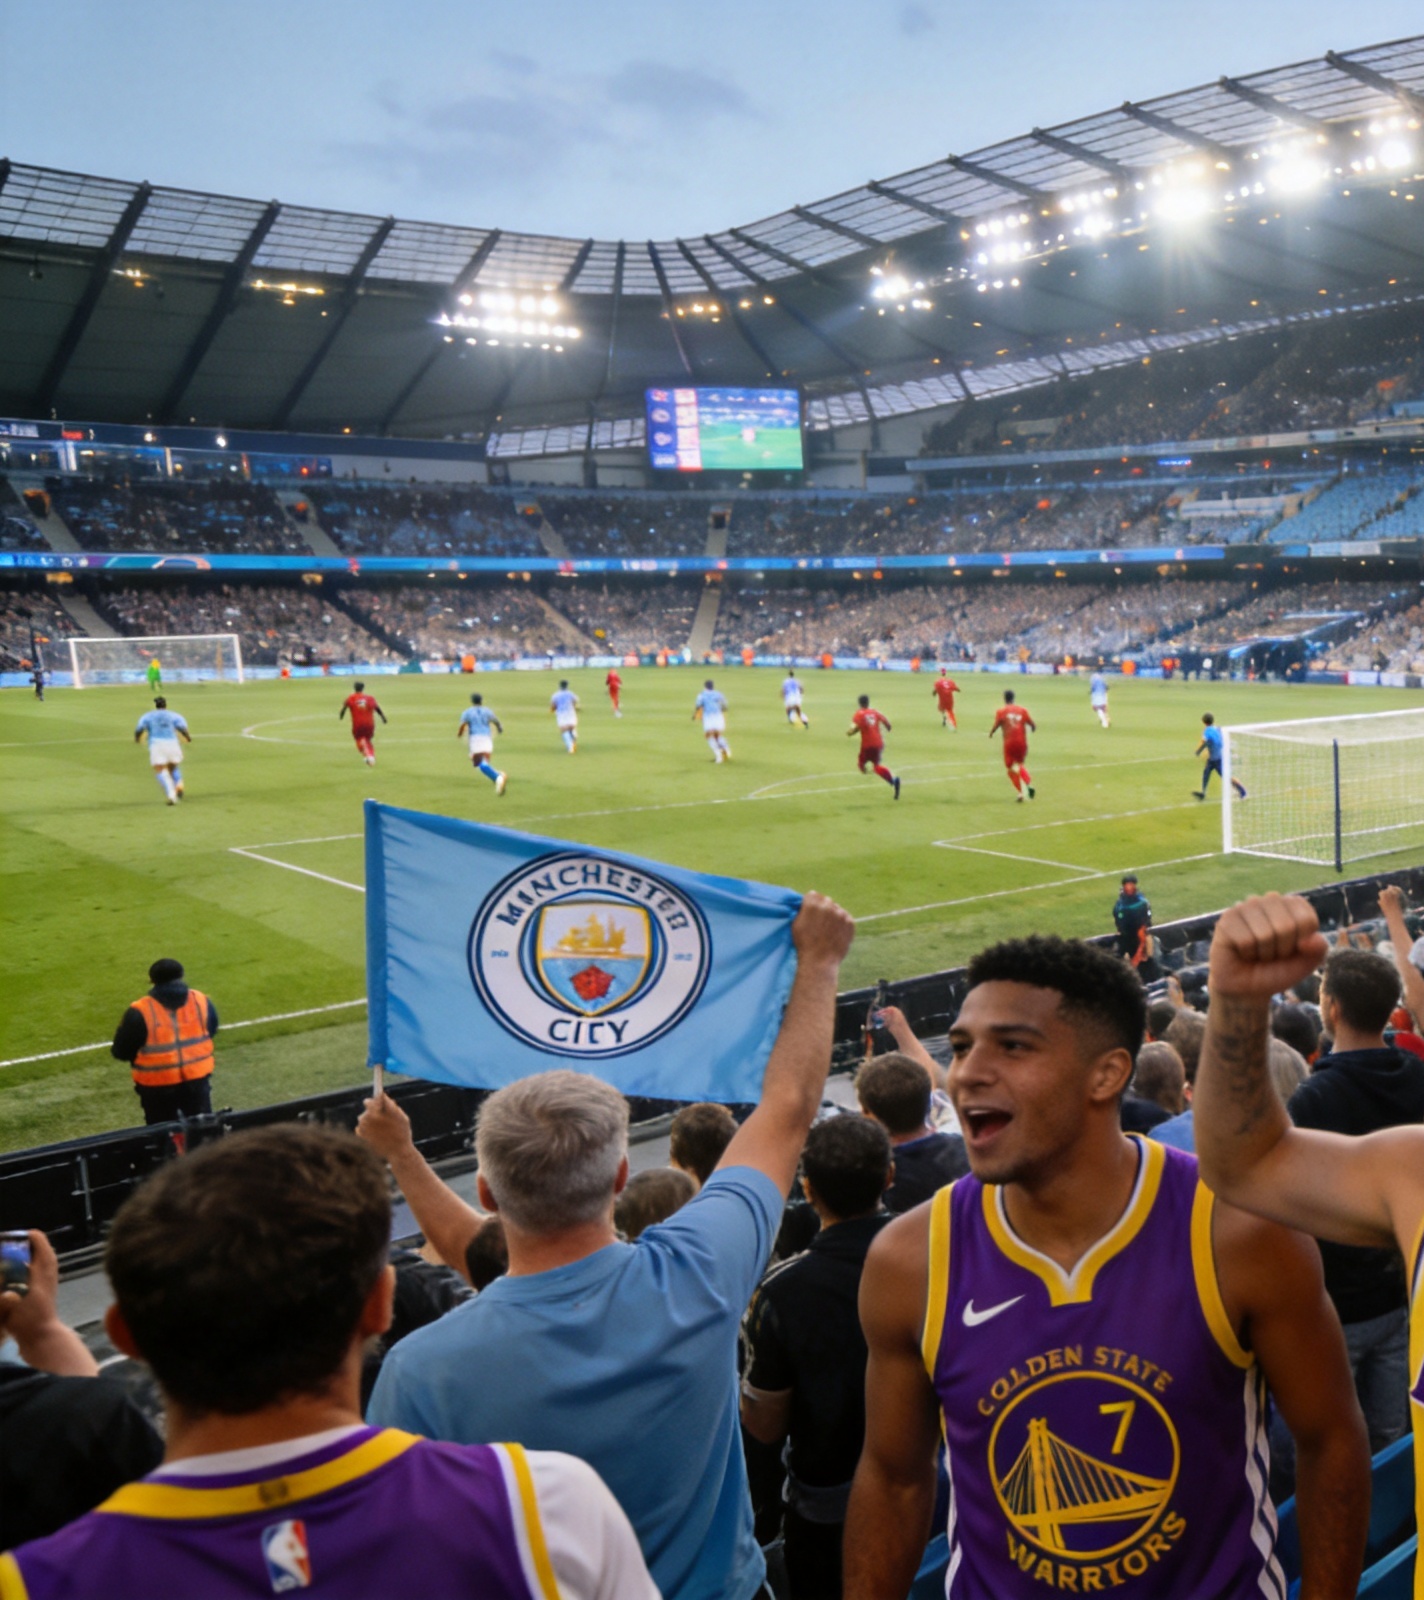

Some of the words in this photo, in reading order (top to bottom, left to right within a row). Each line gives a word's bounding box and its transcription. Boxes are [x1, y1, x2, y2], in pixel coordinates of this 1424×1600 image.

[1094, 1345, 1174, 1392] STATE
[1099, 1400, 1136, 1455] 7
[1006, 1511, 1187, 1592] WARRIORS
